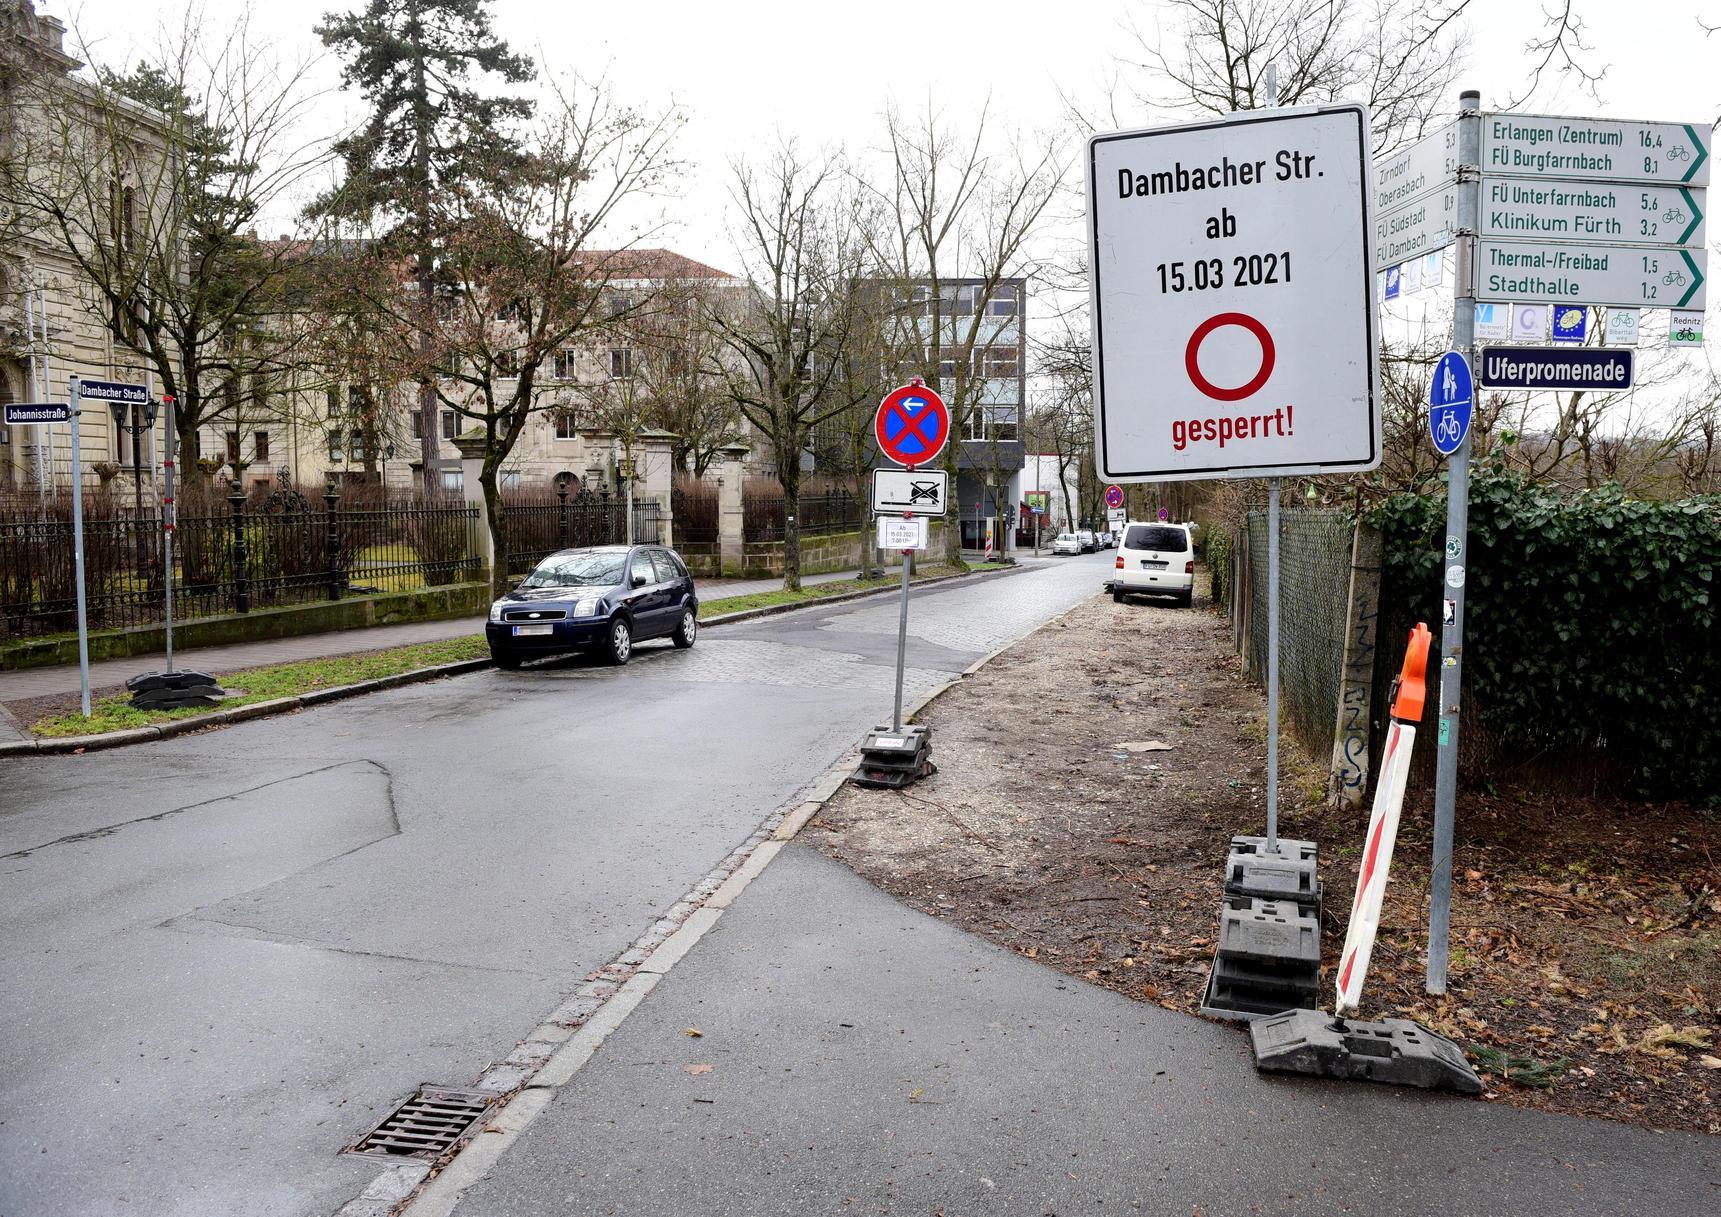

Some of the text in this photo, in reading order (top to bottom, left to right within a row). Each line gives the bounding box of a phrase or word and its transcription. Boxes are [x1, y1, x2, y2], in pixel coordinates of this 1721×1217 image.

[1446, 133, 1455, 149] 5,3
[1494, 122, 1662, 148] Erlangen (Zentrum) 16,4
[1119, 150, 1324, 198] Dambacher Str.
[1379, 155, 1411, 185] Zirndorf
[1493, 148, 1658, 174] FÜ Burgfarrnbach 8,1
[1379, 172, 1454, 211] Oberasbach 0,9
[1492, 186, 1658, 211] FÜ Unterfarrnbach 5,6
[1206, 208, 1237, 239] ab
[1377, 220, 1389, 240] FÜ
[1391, 207, 1426, 234] Südstadt
[1492, 212, 1657, 236] Klinikum Fürth 3,2
[1377, 230, 1426, 263] FÜ Dambach
[1157, 252, 1291, 293] 15.03 2021
[1491, 249, 1658, 274] Thermal-/Freibad 1,5
[1489, 275, 1657, 299] Stadthalle 1,2
[1674, 317, 1701, 326] Rednitz
[1488, 357, 1624, 384] Uferpromenade
[82, 385, 146, 400] Dambacher Straße
[9, 407, 66, 419] Johannisstraße
[1172, 406, 1293, 451] gesperrt!
